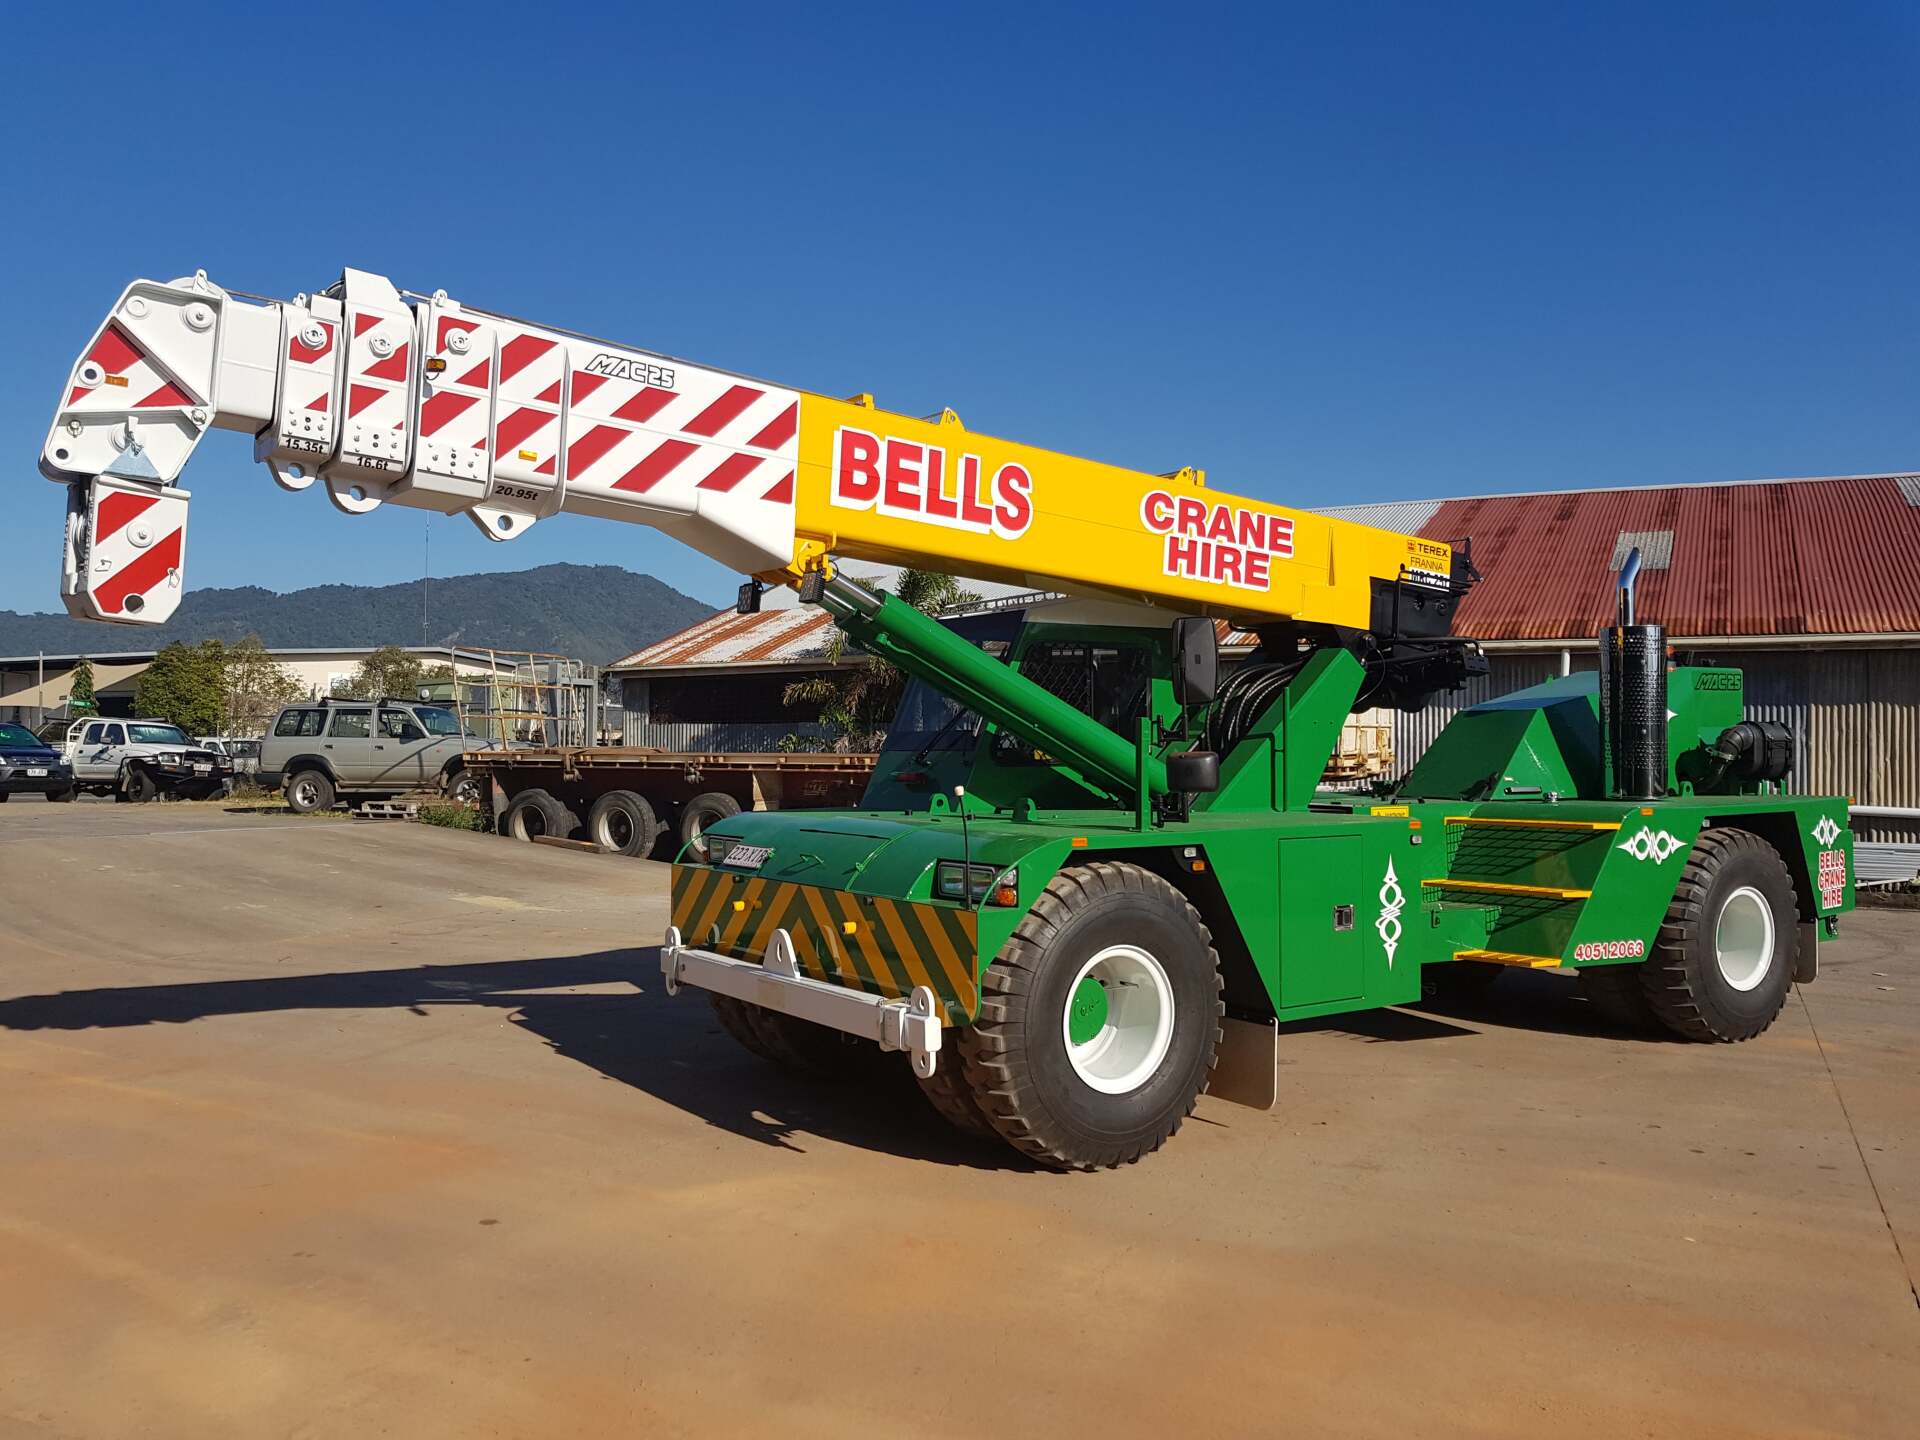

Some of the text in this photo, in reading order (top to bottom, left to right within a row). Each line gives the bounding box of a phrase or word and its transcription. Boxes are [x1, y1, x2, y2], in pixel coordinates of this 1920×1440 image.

[285, 438, 324, 455] 15.35t
[356, 457, 389, 471] 16.6t
[832, 425, 1033, 539] BELLS
[495, 485, 539, 501] 20.95t
[1142, 491, 1293, 557] CRANE
[1417, 543, 1449, 558] TEREX
[1164, 534, 1270, 590] HIRE
[1410, 556, 1444, 571] FRANNA
[1819, 850, 1845, 869] BELLS
[1818, 869, 1846, 890] CRANE
[1822, 888, 1842, 909] HIRE
[1575, 940, 1644, 960] 40512063
